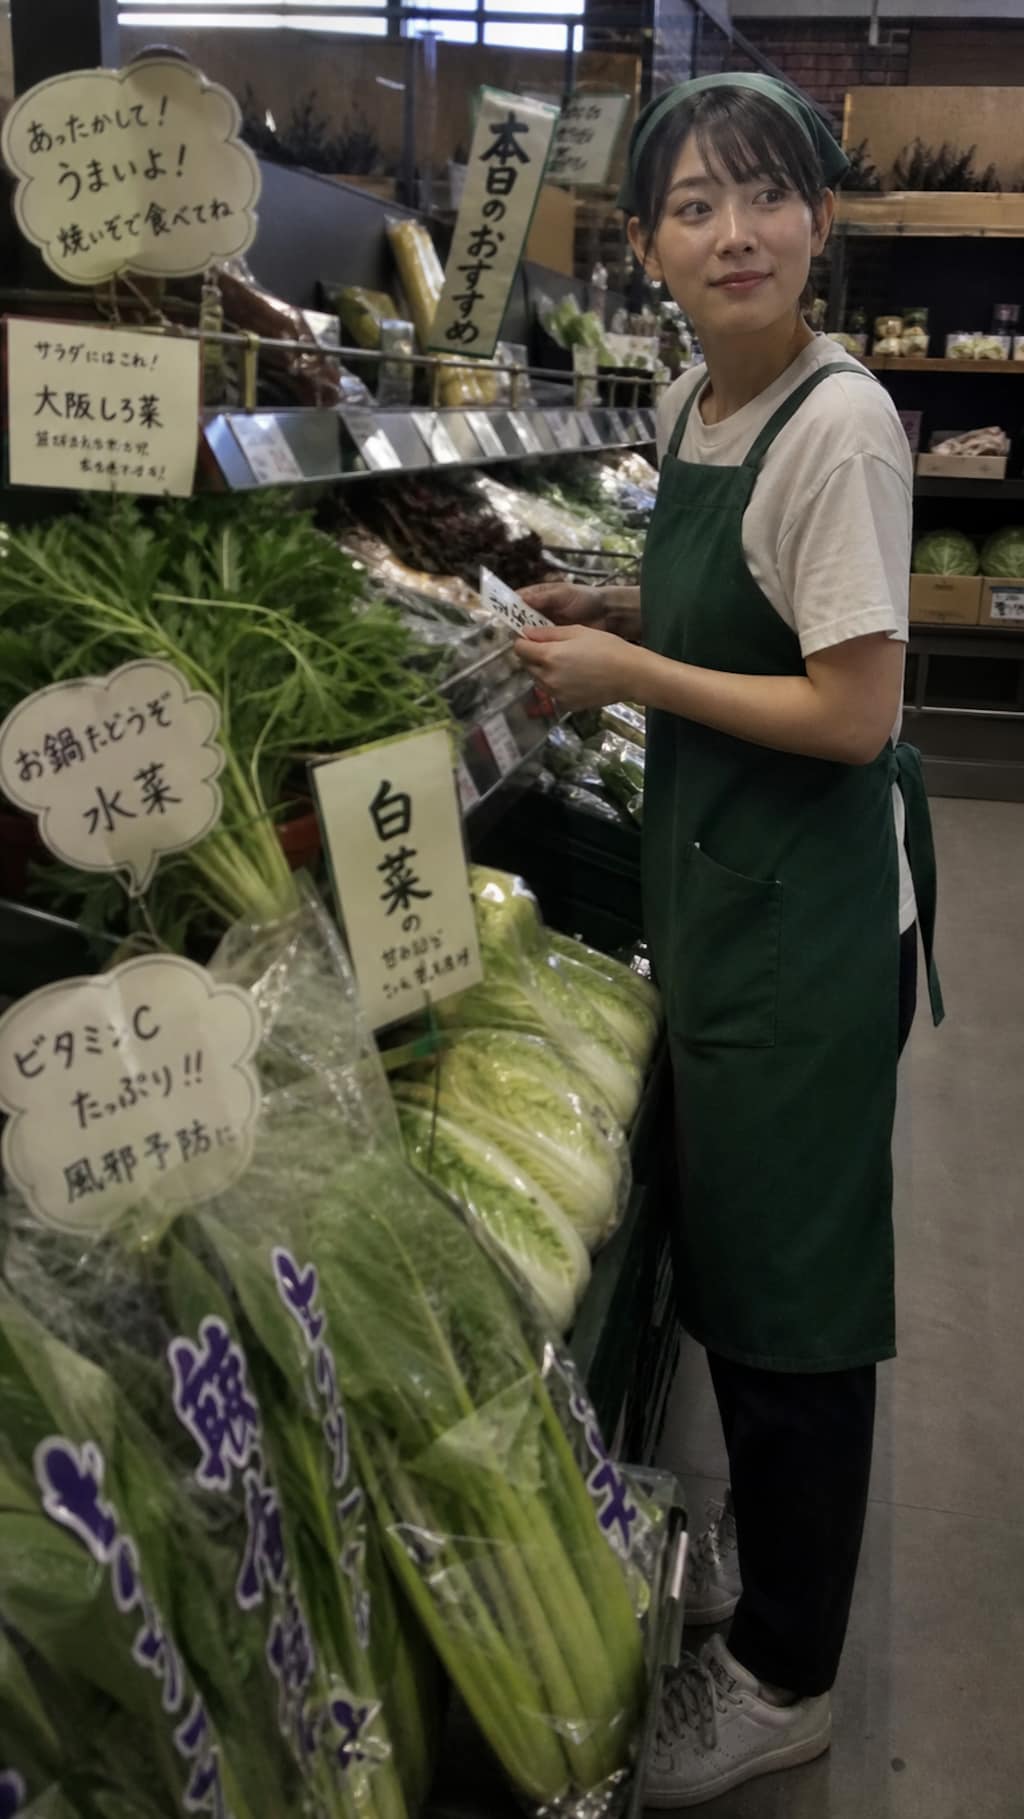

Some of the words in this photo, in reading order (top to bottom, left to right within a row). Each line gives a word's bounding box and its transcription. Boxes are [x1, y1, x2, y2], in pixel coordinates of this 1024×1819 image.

[58, 143, 187, 201] うまいよ!
[445, 110, 531, 344] 本日のおすすめ
[34, 384, 164, 429] 大阪しろ菜
[82, 762, 182, 835] 水菜
[368, 779, 433, 932] 白菜の
